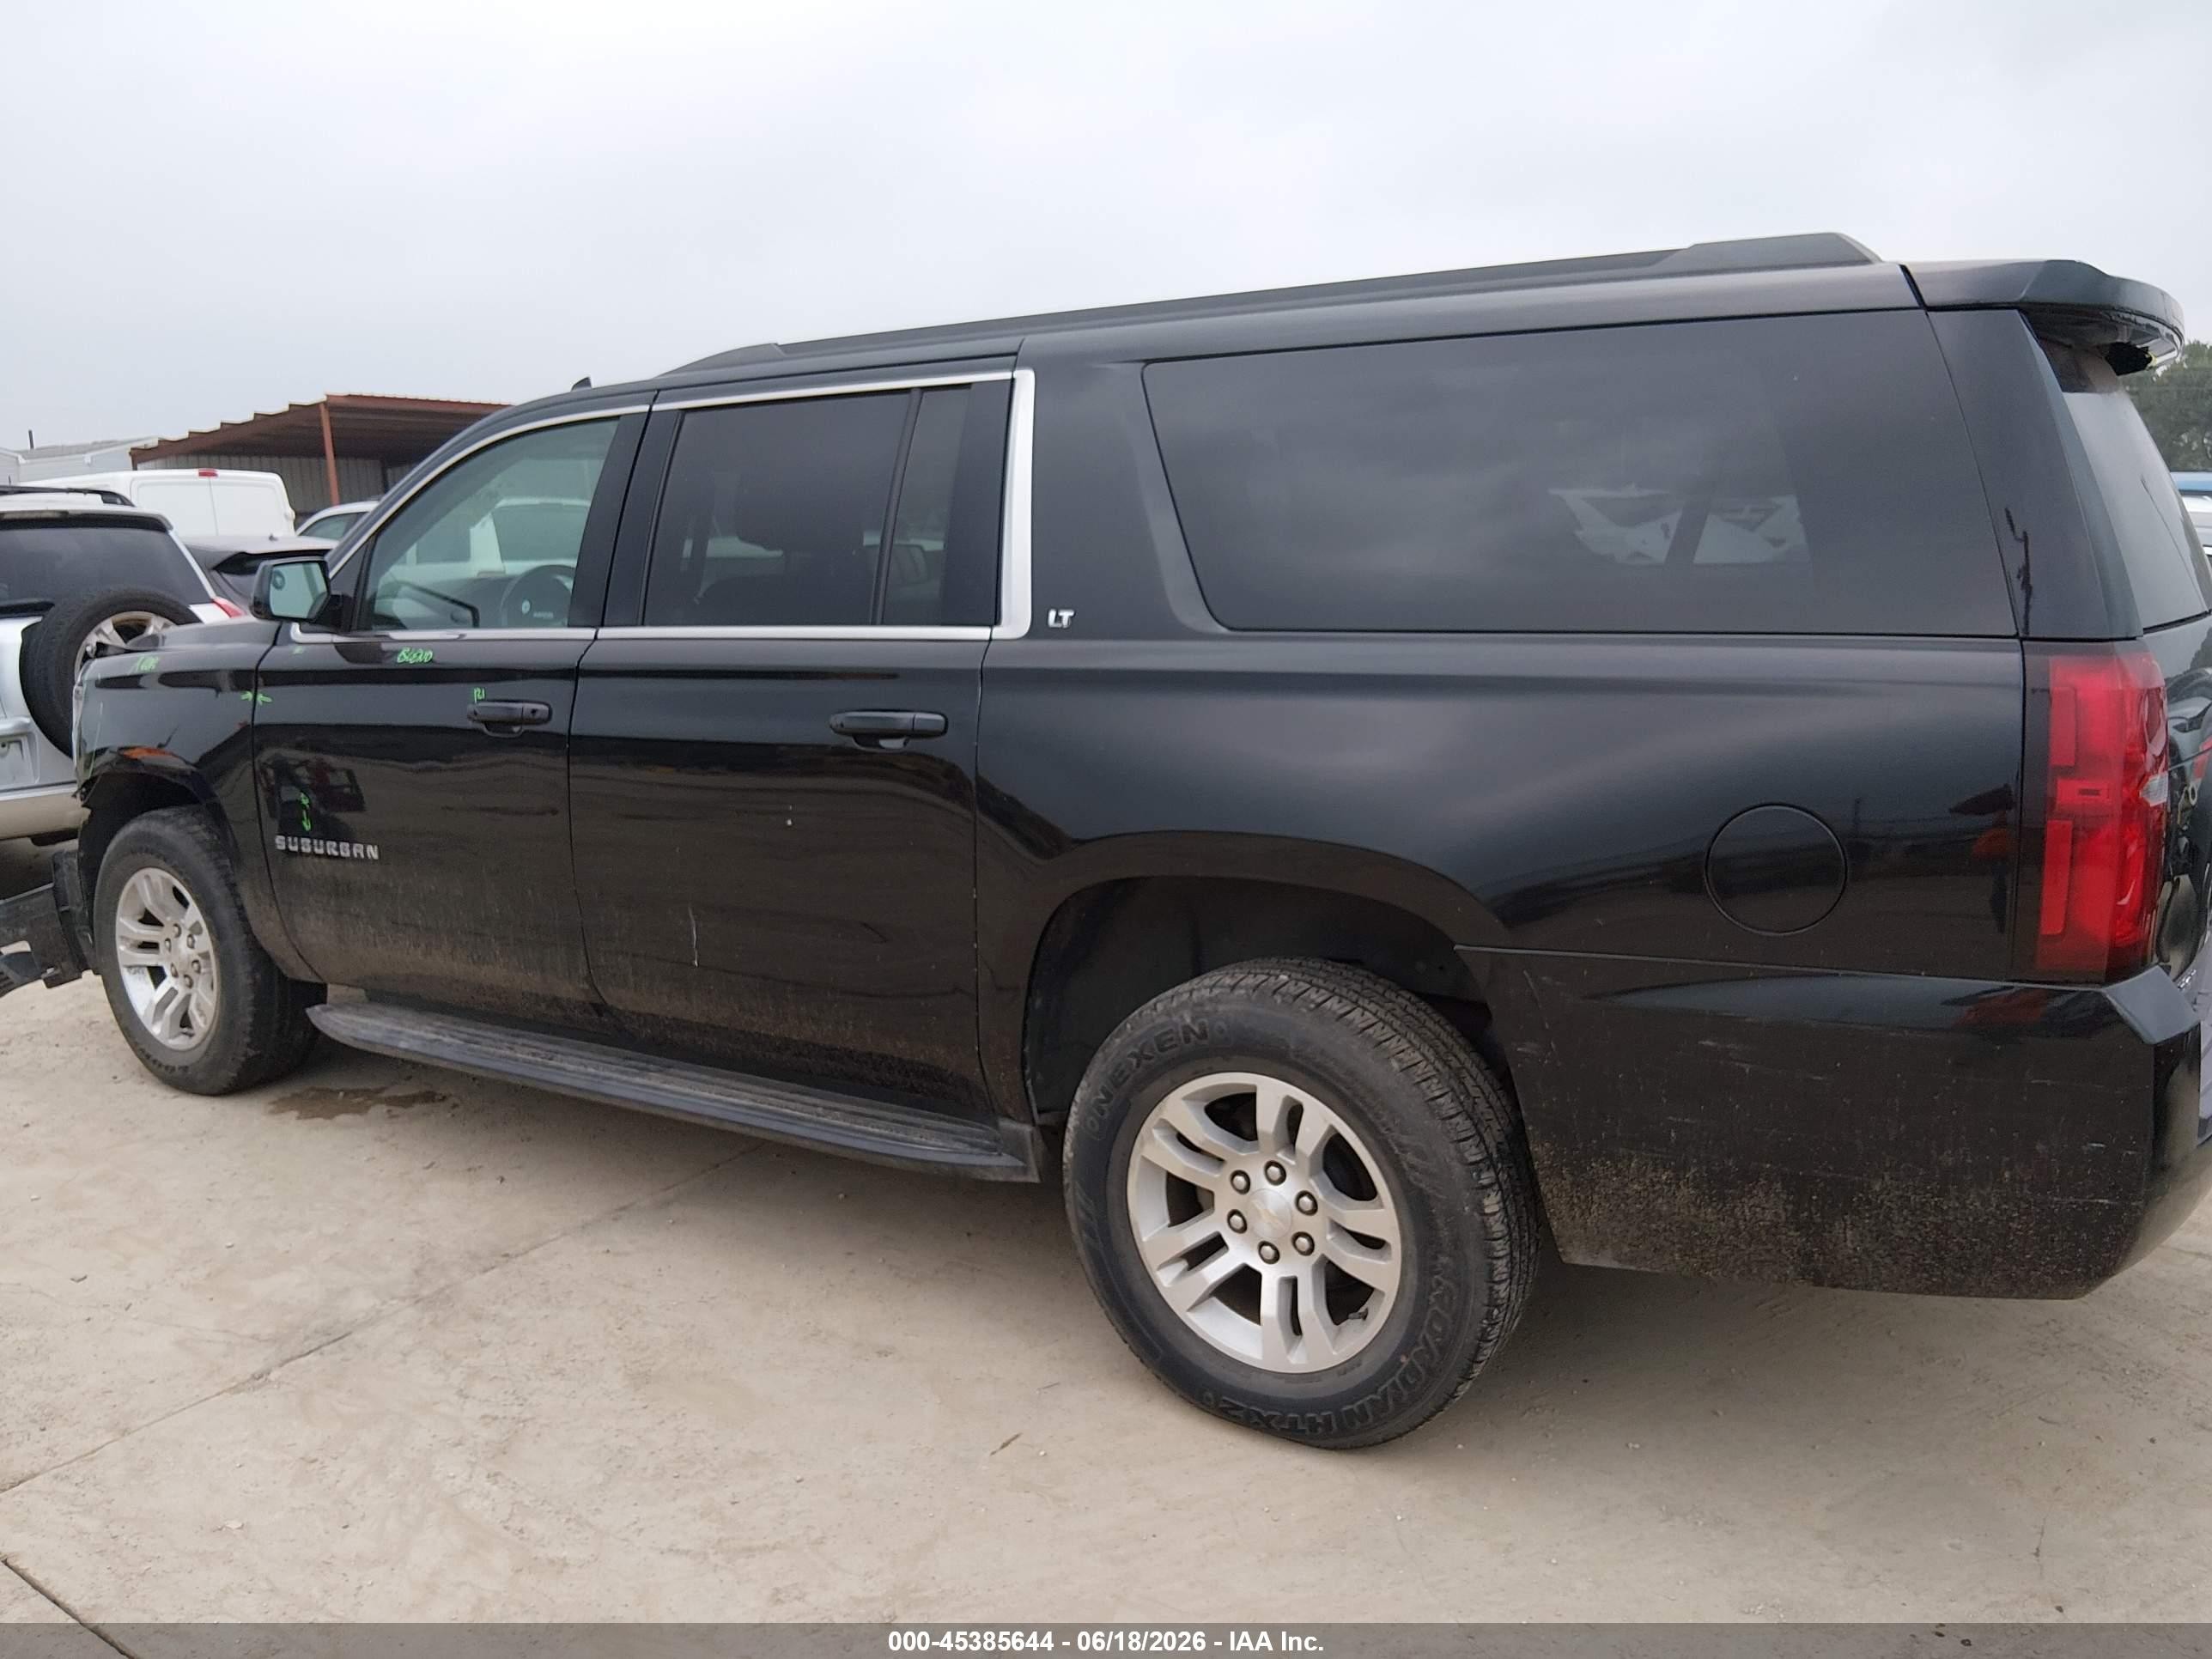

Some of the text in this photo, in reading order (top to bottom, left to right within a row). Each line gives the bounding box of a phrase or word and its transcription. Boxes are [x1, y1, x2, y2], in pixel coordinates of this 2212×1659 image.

[1048, 609, 1074, 628] LT
[276, 835, 379, 860] SUBURBAN
[1092, 1018, 1208, 1116] NEXEN
